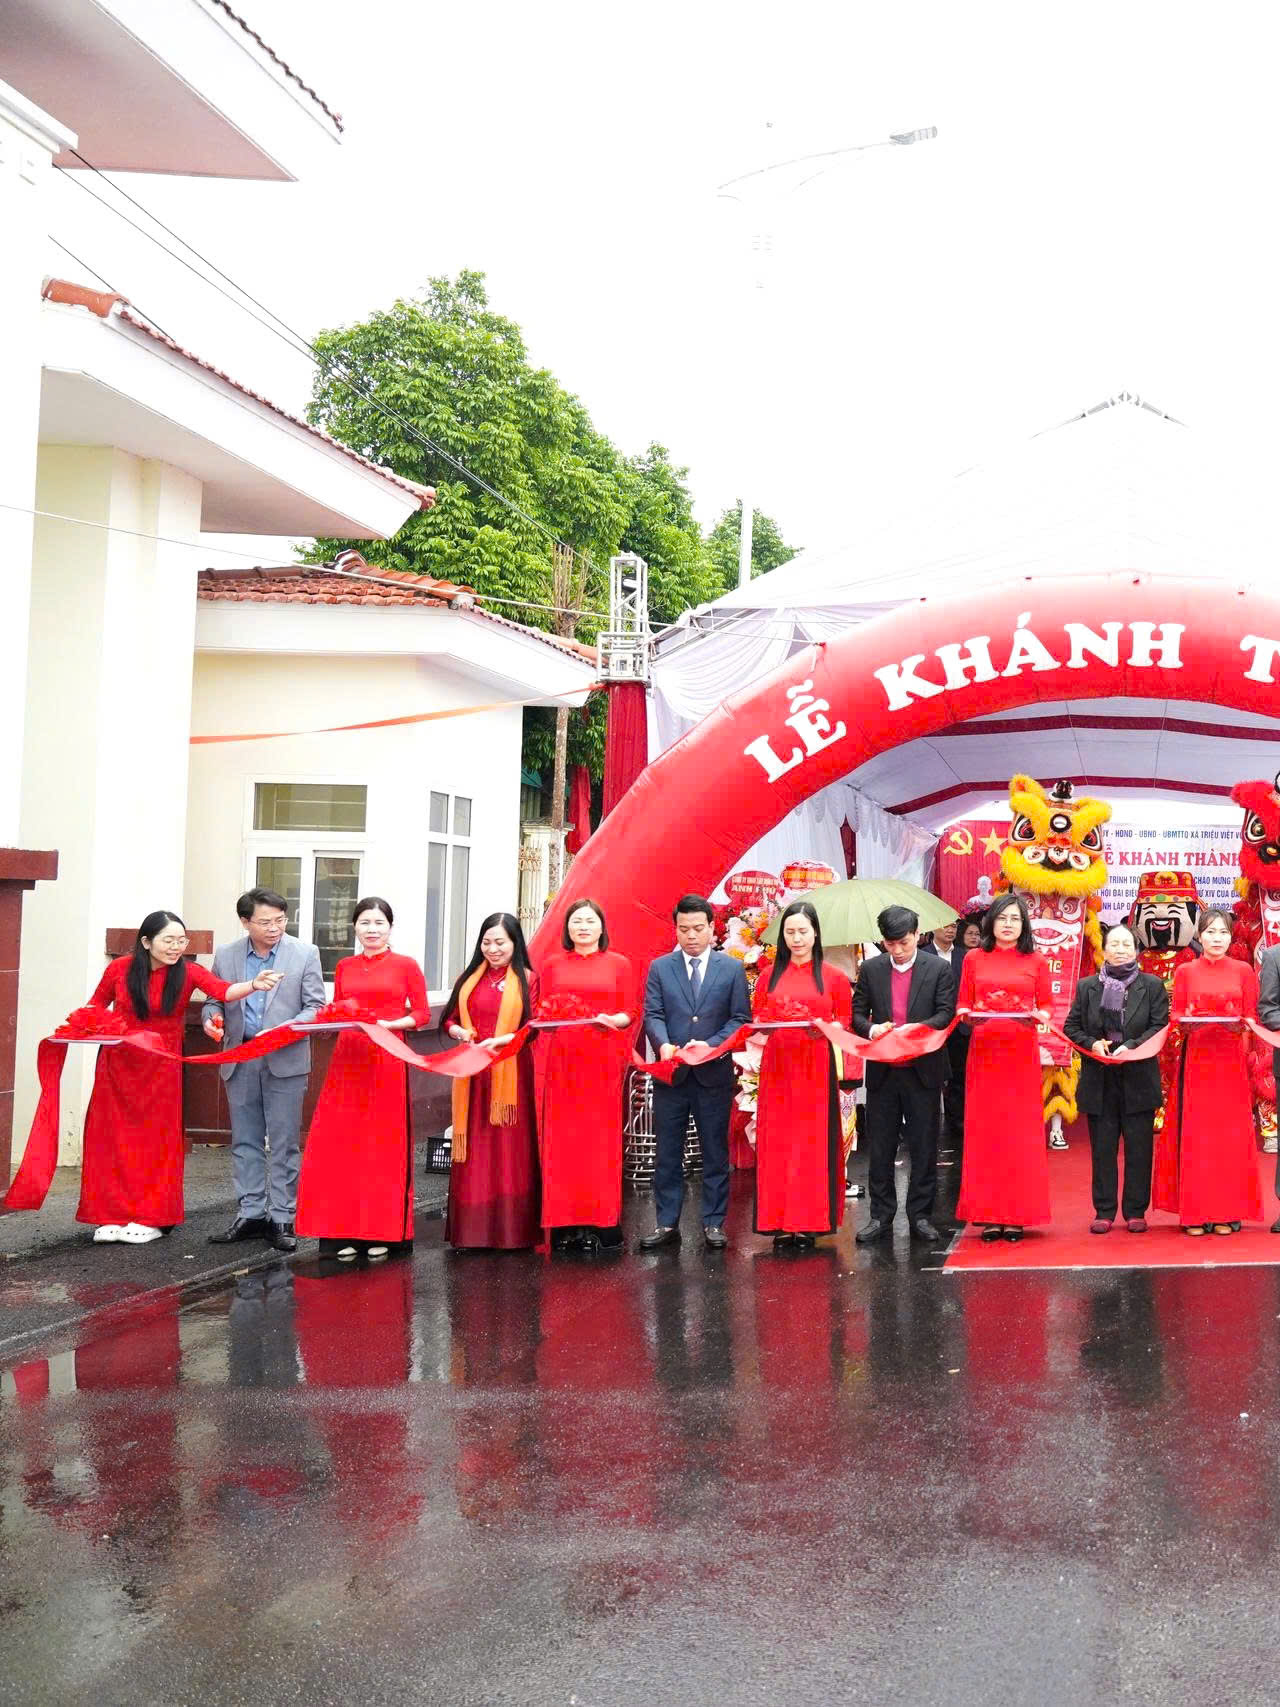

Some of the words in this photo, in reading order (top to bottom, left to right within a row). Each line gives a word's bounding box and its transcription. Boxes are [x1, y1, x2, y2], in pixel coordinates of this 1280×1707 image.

[744, 680, 846, 783] LỄ
[874, 612, 1186, 711] KHÁNH
[1119, 848, 1180, 866] KHÁNH
